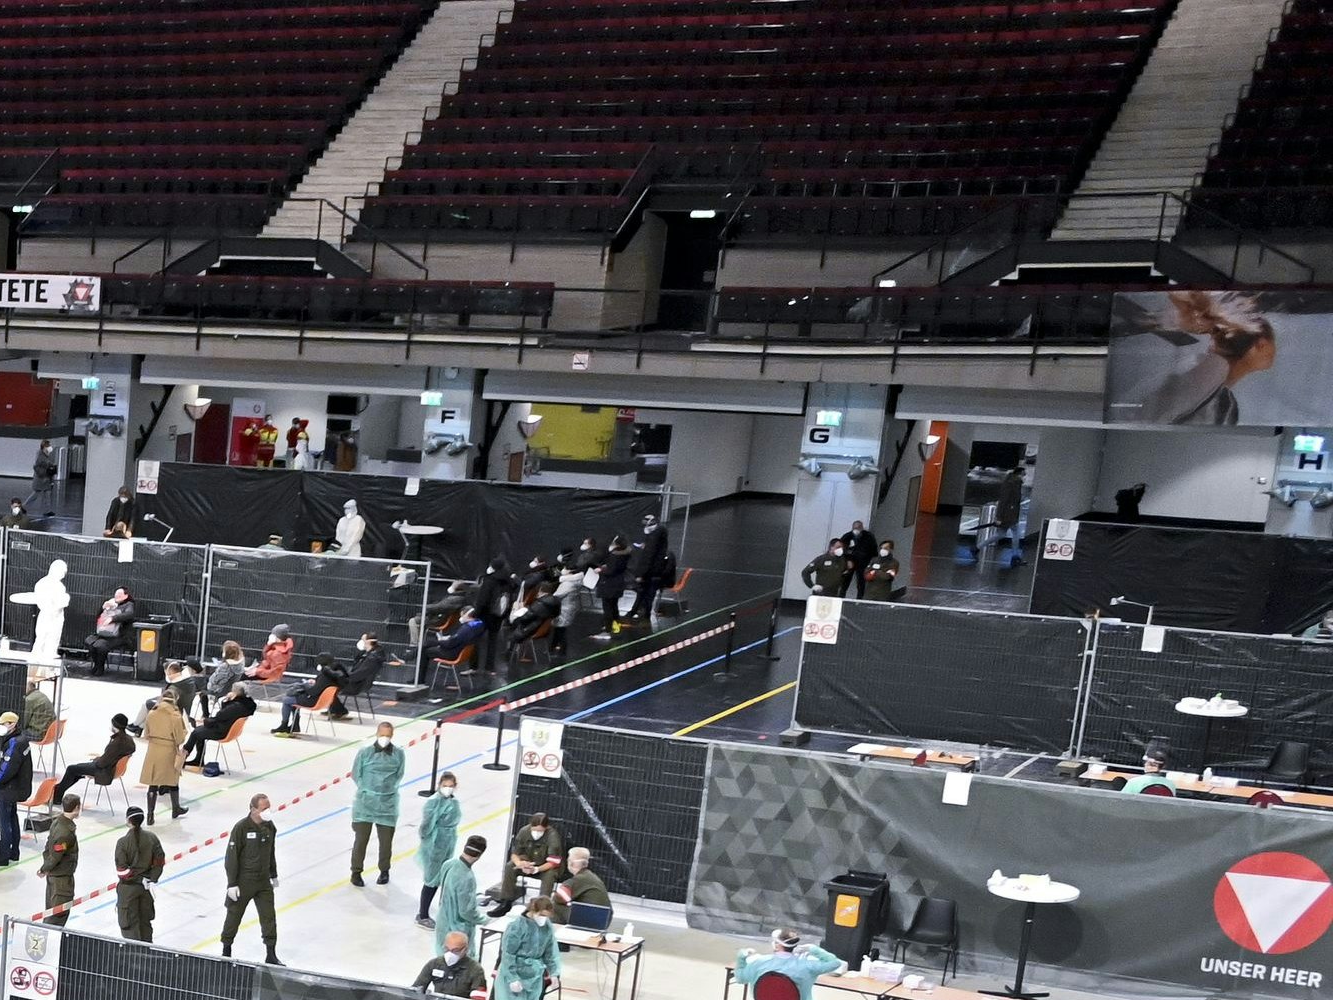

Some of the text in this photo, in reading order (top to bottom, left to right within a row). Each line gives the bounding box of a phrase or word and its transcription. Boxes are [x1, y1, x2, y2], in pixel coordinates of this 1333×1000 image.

[103, 393, 116, 407] E
[440, 410, 455, 424] F
[809, 427, 830, 444] G
[1298, 453, 1324, 470] H
[1200, 957, 1322, 988] UNSER HEER
